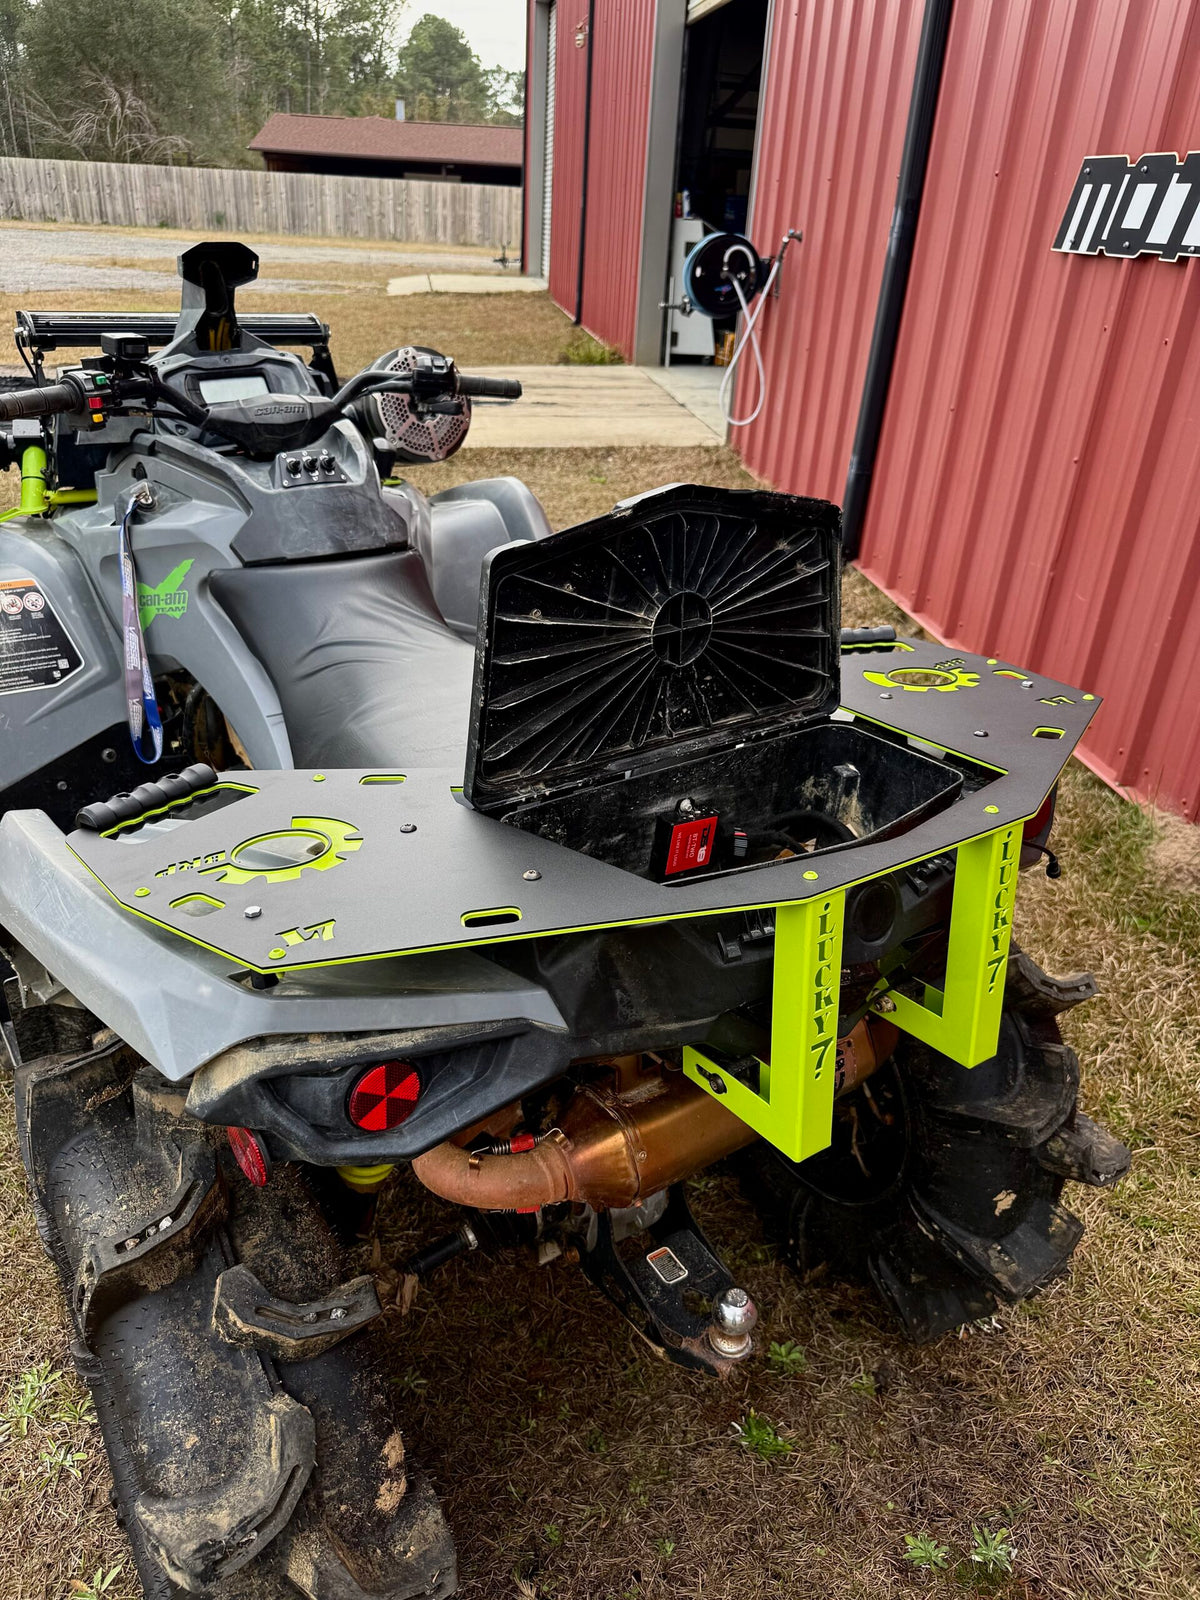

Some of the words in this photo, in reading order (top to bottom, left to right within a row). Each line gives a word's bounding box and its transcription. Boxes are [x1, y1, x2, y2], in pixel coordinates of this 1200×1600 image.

[255, 404, 306, 417] can-am
[140, 591, 187, 607] can-am
[155, 605, 187, 613] TEAM
